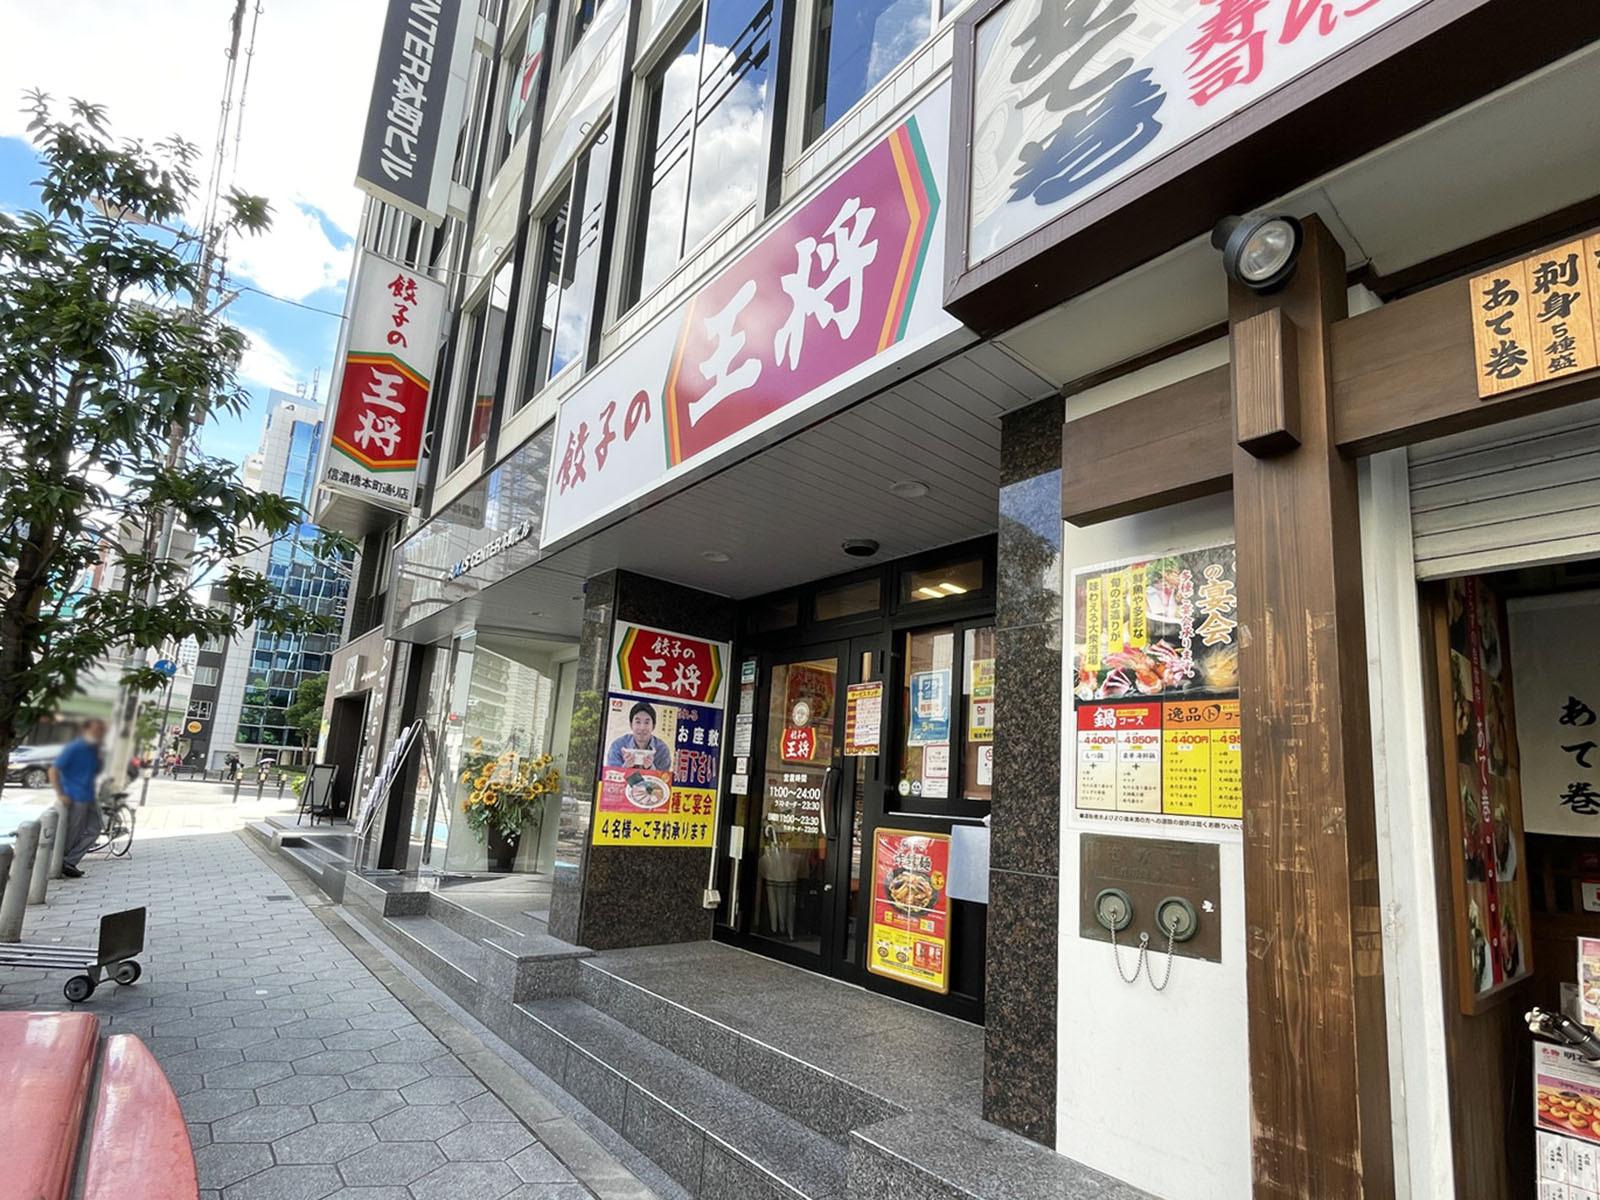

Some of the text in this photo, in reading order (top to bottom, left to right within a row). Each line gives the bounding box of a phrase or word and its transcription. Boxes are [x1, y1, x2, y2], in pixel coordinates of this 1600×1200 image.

[387, 273, 418, 348] 餃子の
[556, 197, 879, 496] 餃子の 王将
[1482, 279, 1529, 379] あて巻
[353, 366, 406, 457] 王将
[327, 466, 410, 500] 信濃橋本町通り店
[638, 656, 701, 697] 王将
[651, 636, 696, 659] 餃子の
[786, 740, 810, 758] 王将
[1559, 696, 1600, 815] あて巻
